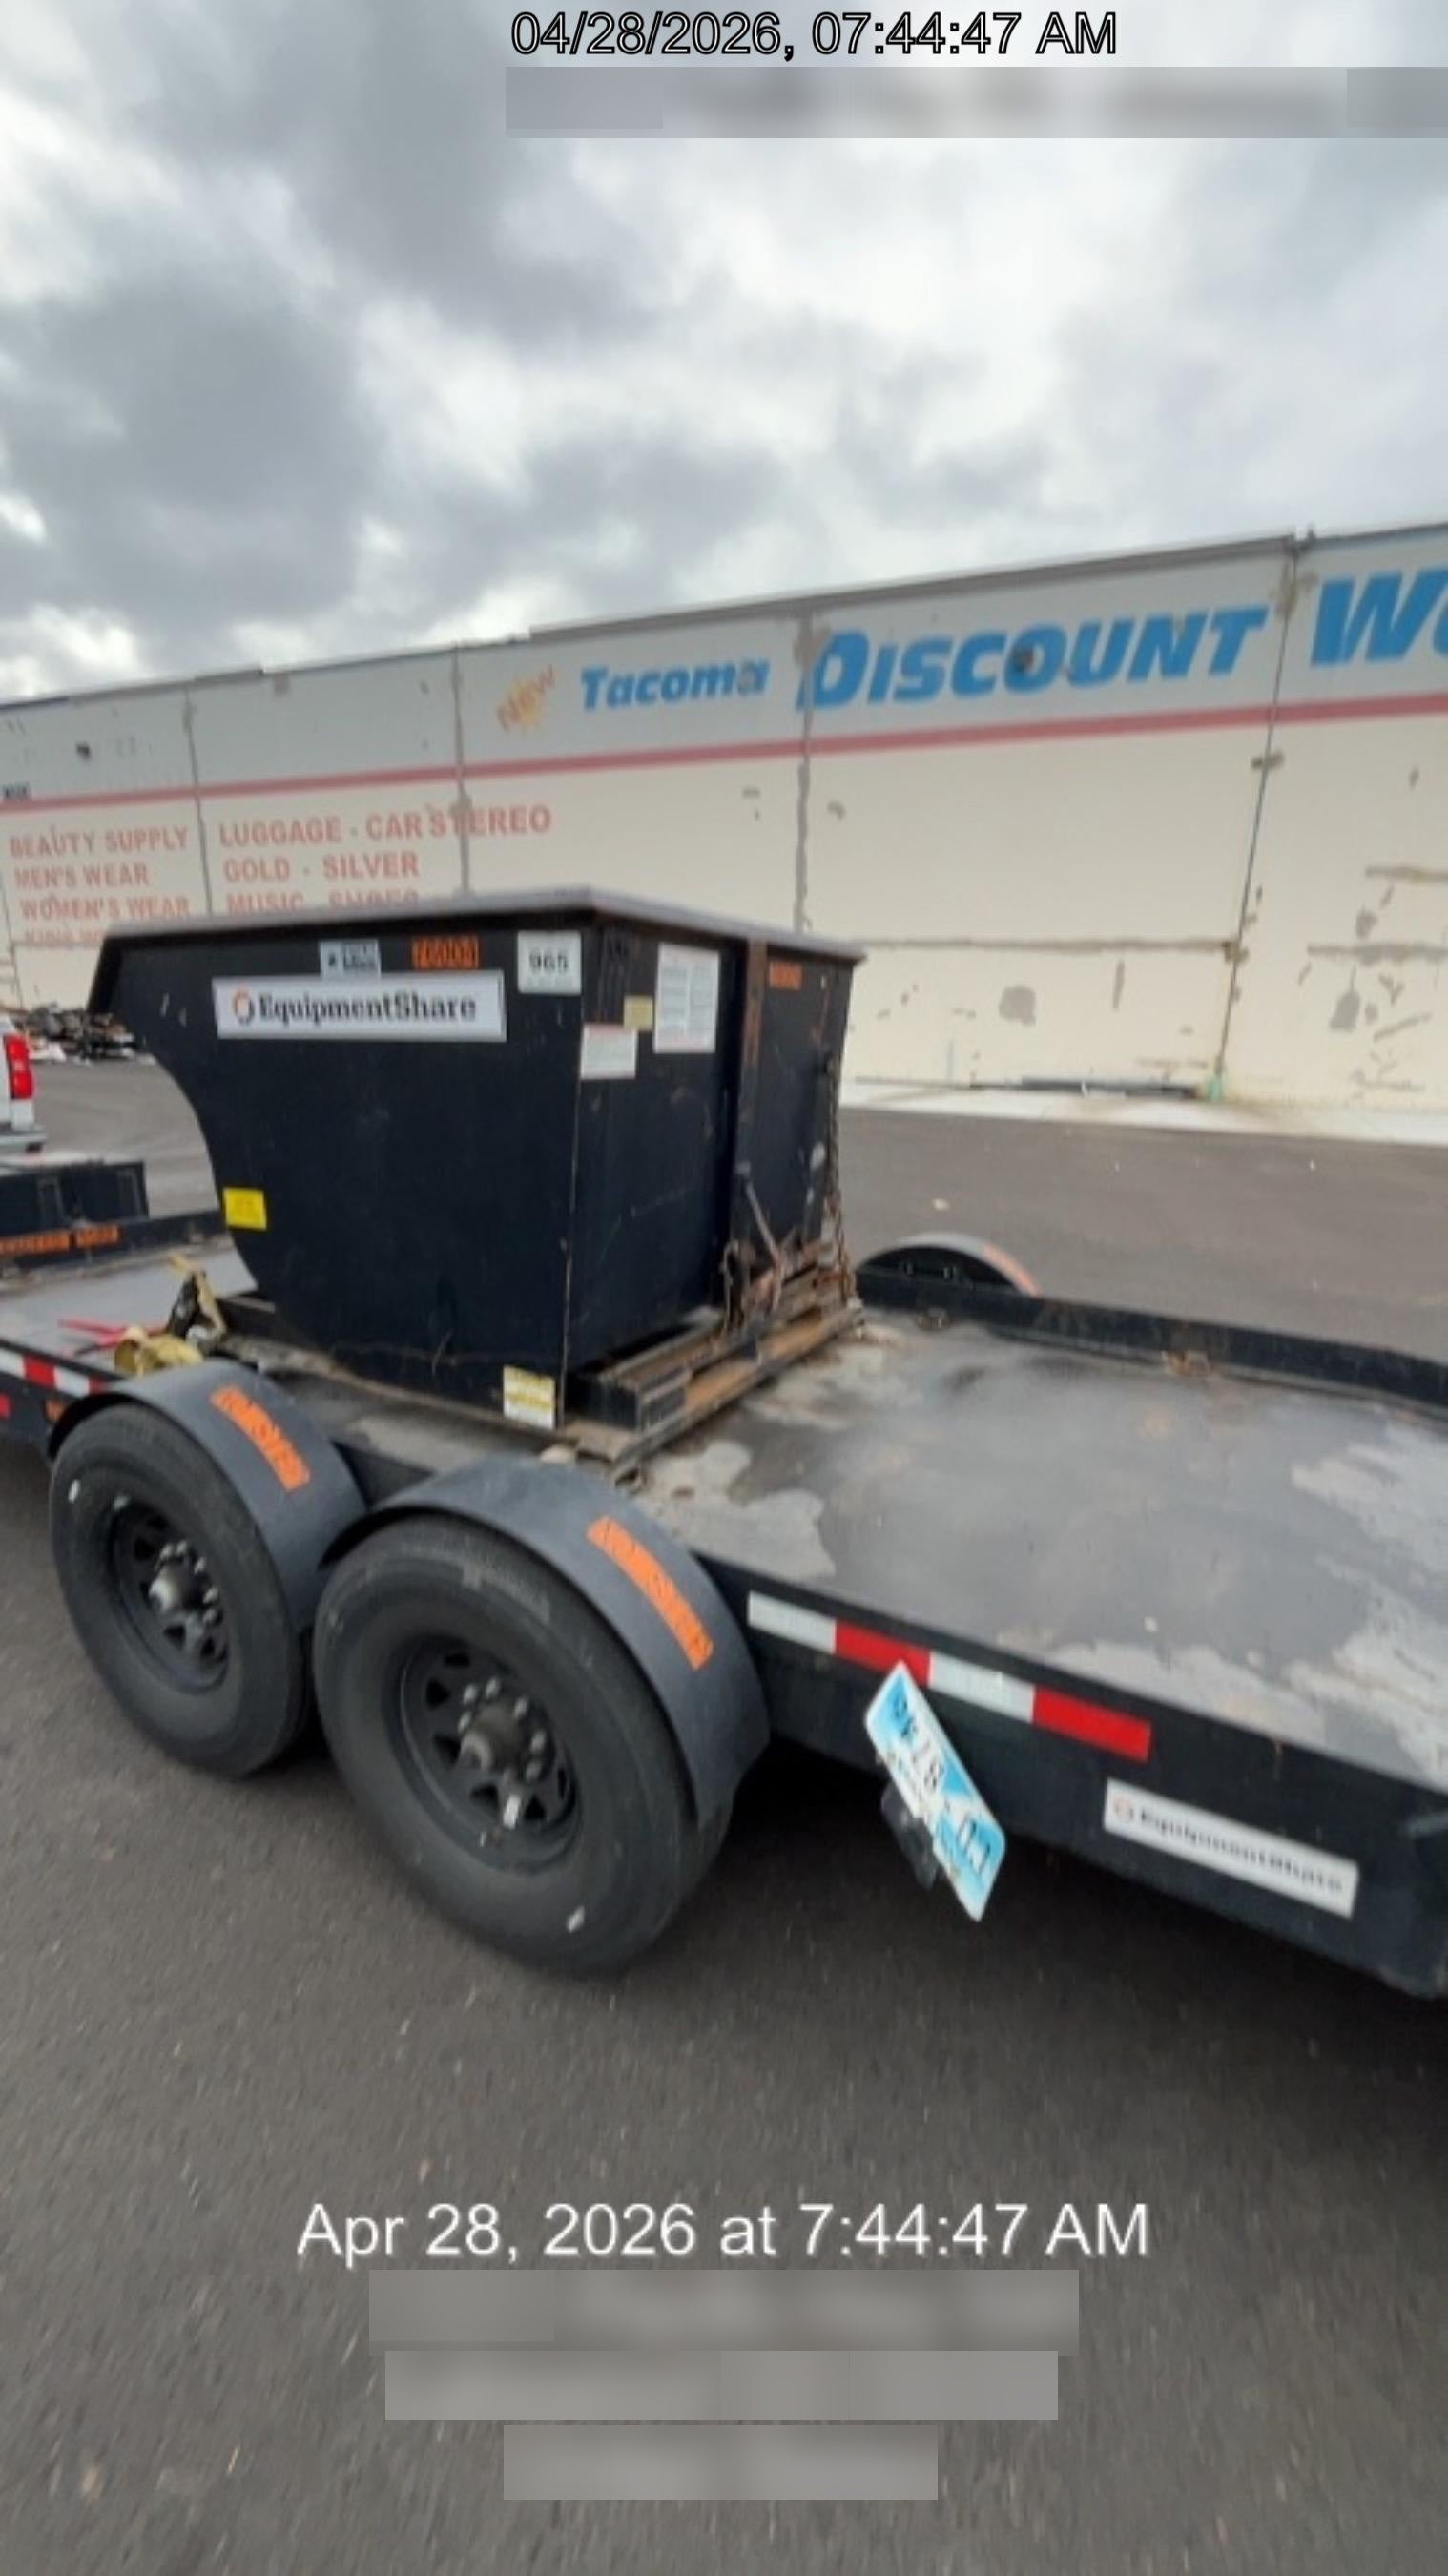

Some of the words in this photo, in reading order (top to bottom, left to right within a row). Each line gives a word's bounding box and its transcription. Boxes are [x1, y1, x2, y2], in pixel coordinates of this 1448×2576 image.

[582, 659, 771, 712] Tacoma
[10, 832, 94, 857] BEAUTY
[104, 825, 188, 852] SUPPLY
[218, 815, 342, 848] LUGGAGE
[365, 811, 423, 841] CAR
[83, 862, 149, 887] WEAR
[223, 857, 290, 883] GOLD
[322, 850, 419, 881] SILVER
[258, 990, 477, 1027] EquipmentShare
